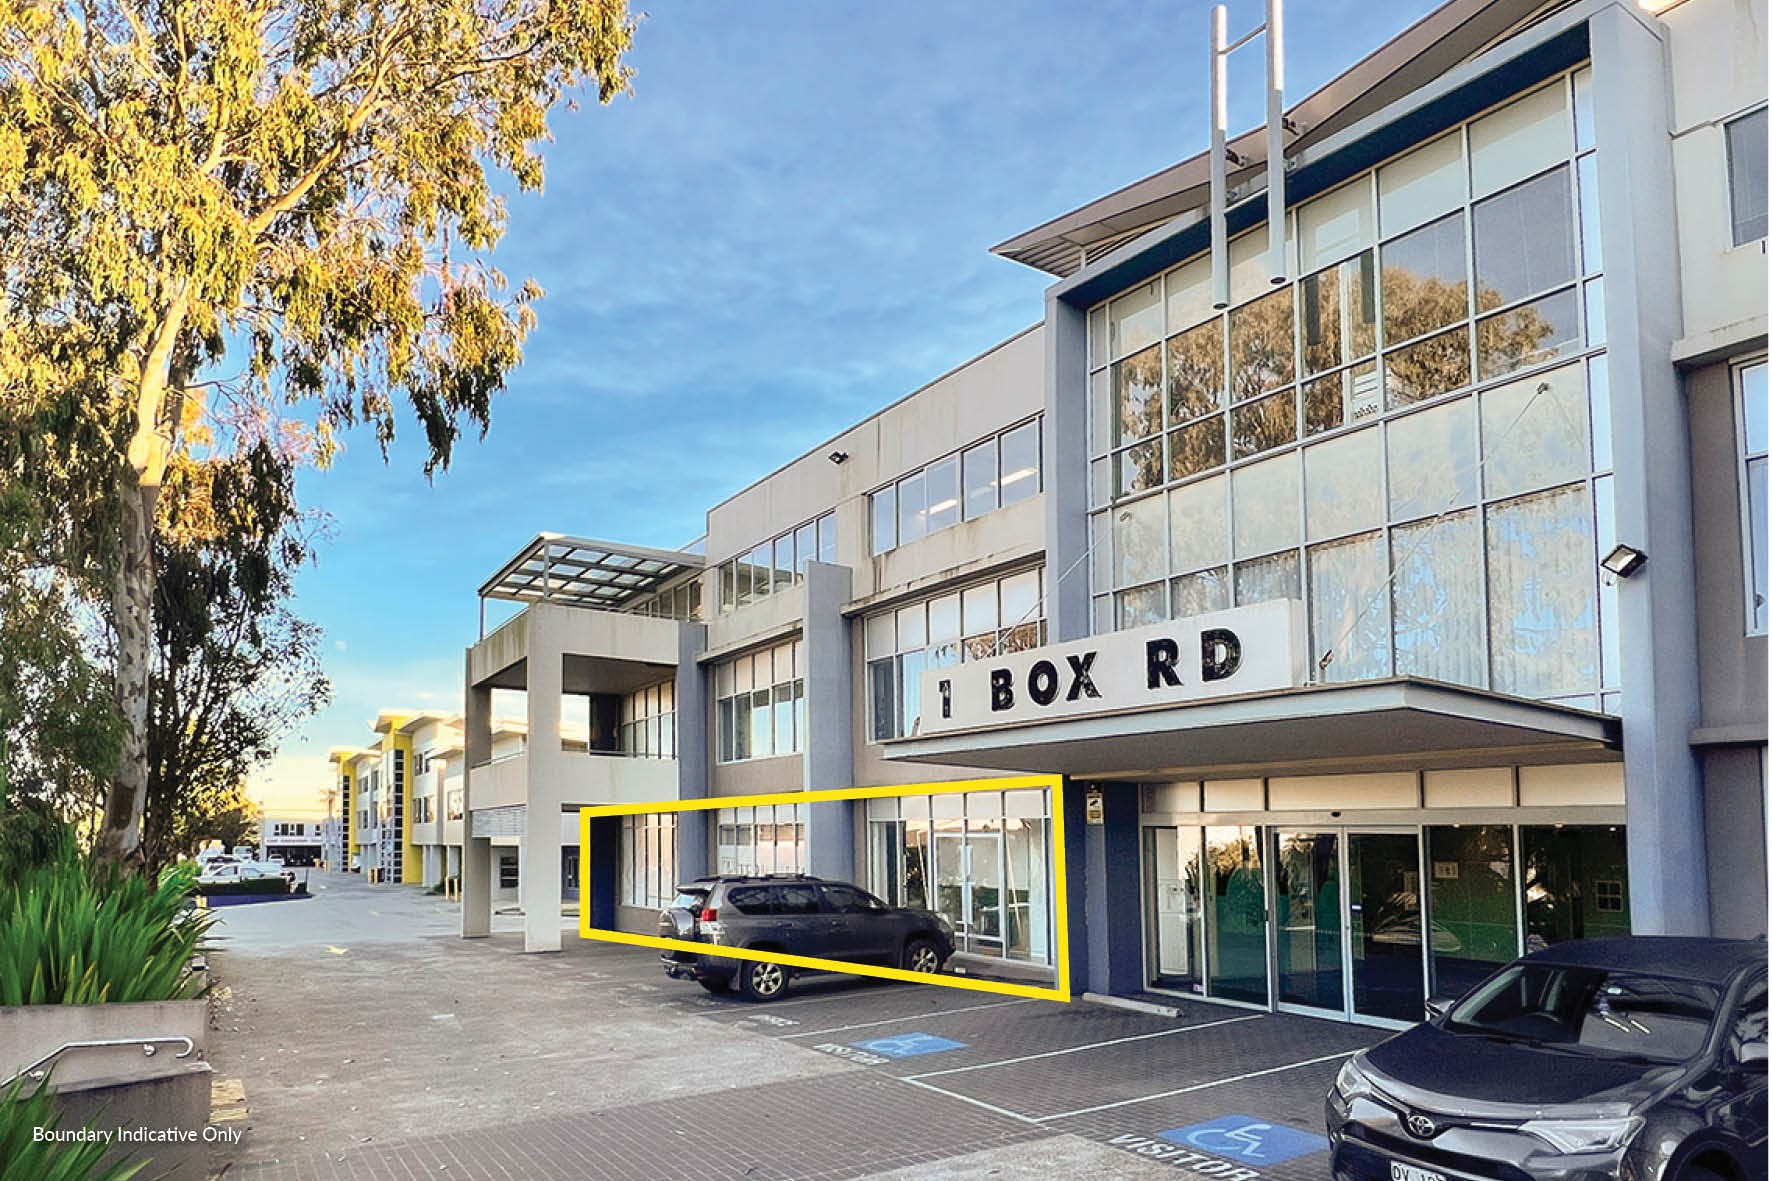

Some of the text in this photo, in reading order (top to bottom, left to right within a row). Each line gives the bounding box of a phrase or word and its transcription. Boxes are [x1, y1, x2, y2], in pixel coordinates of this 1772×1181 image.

[938, 628, 1243, 719] 1 BOX RD
[1107, 1132, 1261, 1181] VISITOR
